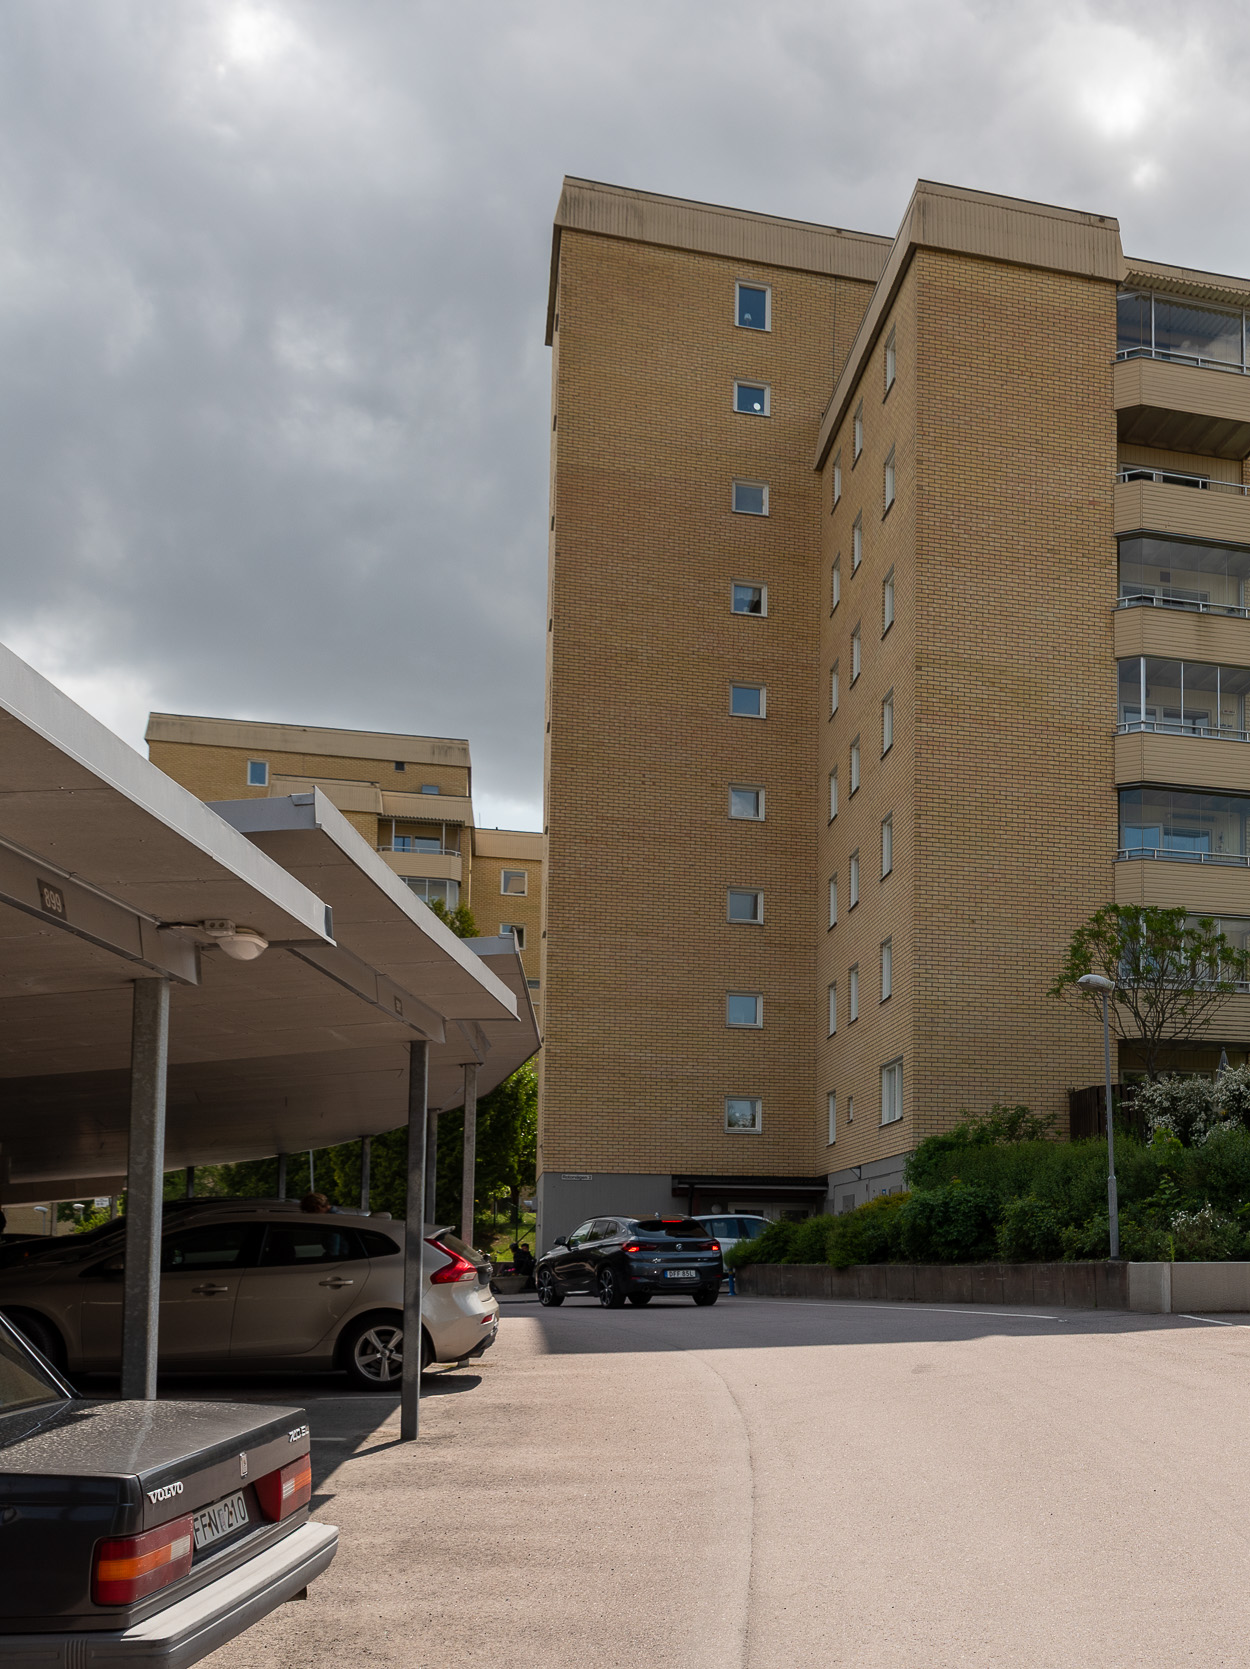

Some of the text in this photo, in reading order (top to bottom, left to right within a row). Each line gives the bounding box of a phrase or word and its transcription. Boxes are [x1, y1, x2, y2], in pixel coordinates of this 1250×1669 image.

[43, 887, 63, 913] 899
[147, 1481, 185, 1504] VOLVO
[223, 1496, 247, 1529] 210
